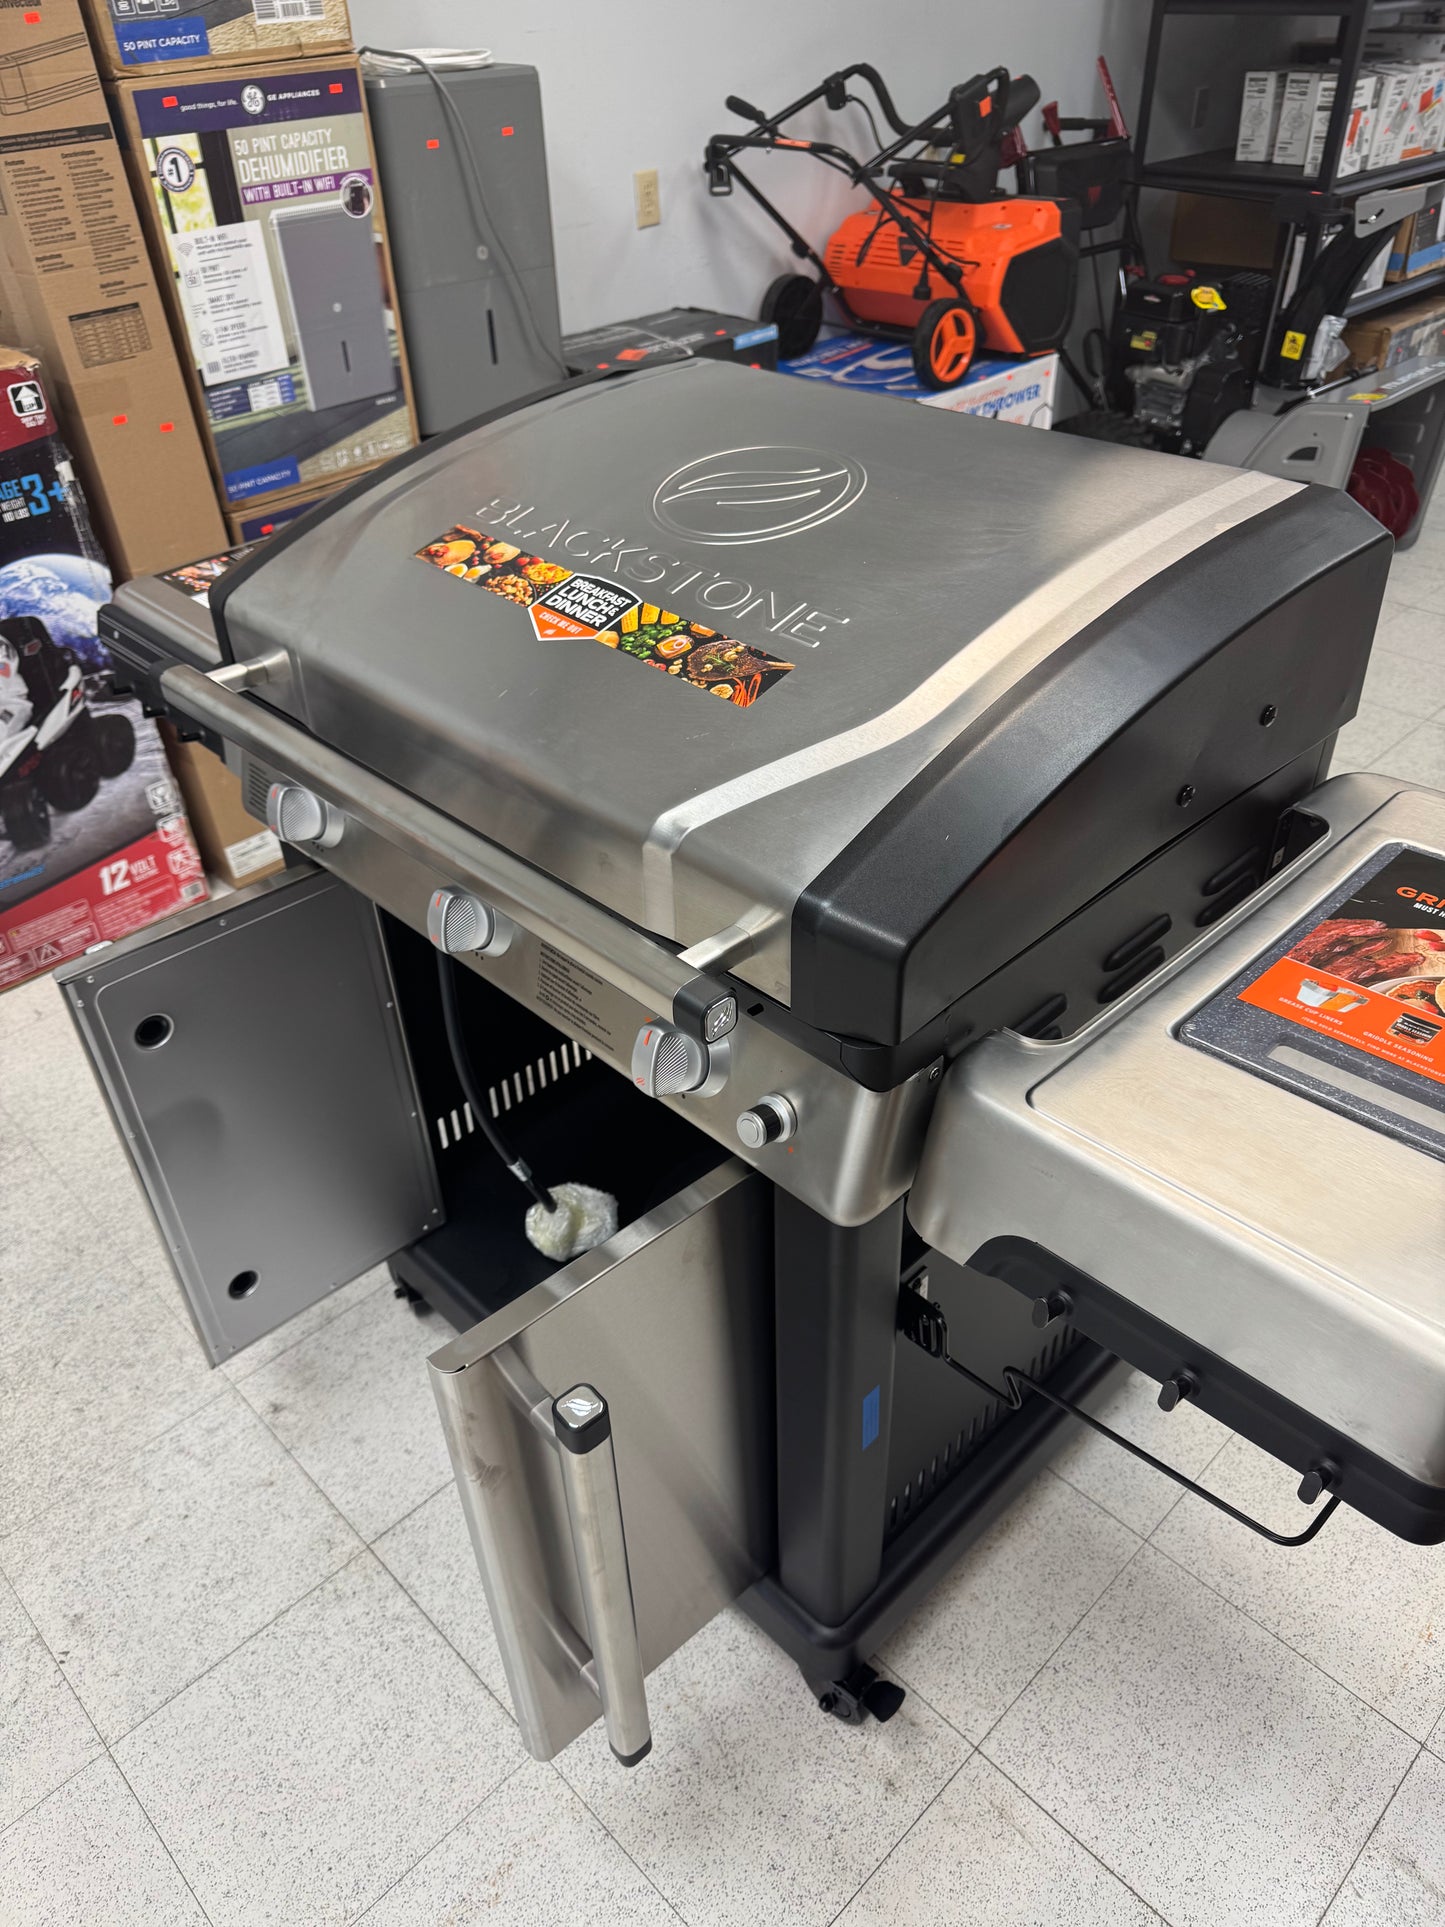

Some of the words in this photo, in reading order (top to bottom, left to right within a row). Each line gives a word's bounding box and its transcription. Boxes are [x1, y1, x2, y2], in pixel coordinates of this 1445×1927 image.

[123, 42, 136, 52] 50
[137, 39, 157, 49] PINT
[158, 34, 200, 47] CAPACITY
[180, 103, 196, 112] good
[267, 93, 276, 101] GE
[278, 89, 320, 100] APPLIANCES
[234, 140, 249, 156] 50
[252, 135, 278, 154] PINT
[280, 128, 332, 149] CAPACITY
[238, 145, 349, 184] DEHUMIDIFIER
[243, 185, 271, 203] WITH
[272, 178, 313, 198] BUILT-IN
[314, 176, 336, 191] WIFI
[982, 384, 1041, 413] THROWER
[20, 473, 70, 516] 3+
[475, 498, 851, 650] BLACKSTONE
[570, 578, 632, 608] BREAKFAST
[539, 611, 559, 625] CHECK
[559, 619, 569, 629] ME
[567, 623, 584, 634] OUT
[545, 594, 608, 628] DINNER
[98, 858, 132, 896] 12
[130, 854, 156, 875] VOLT
[1413, 902, 1440, 915] MUST
[1278, 997, 1305, 1010] GREASE
[1319, 1013, 1344, 1026] LINERS
[1363, 1031, 1393, 1046] GRIDDLE
[1393, 1044, 1435, 1063] SEASONING
